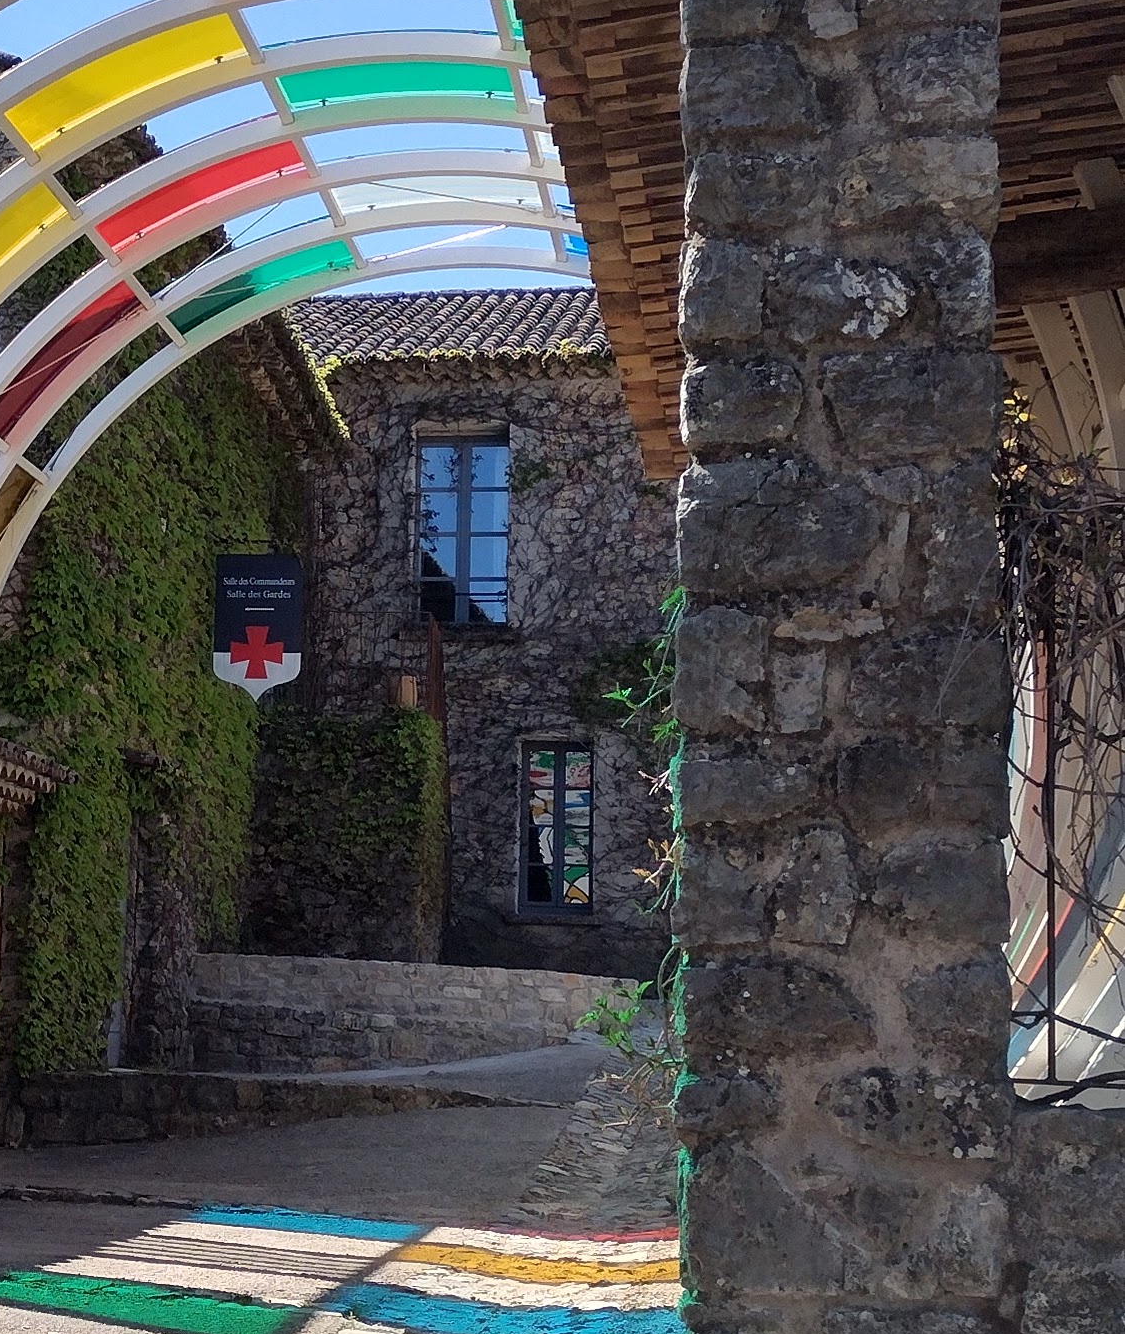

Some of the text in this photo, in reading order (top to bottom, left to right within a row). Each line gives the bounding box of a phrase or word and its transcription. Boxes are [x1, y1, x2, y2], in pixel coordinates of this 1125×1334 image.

[226, 589, 291, 599] Salle des Gardes
